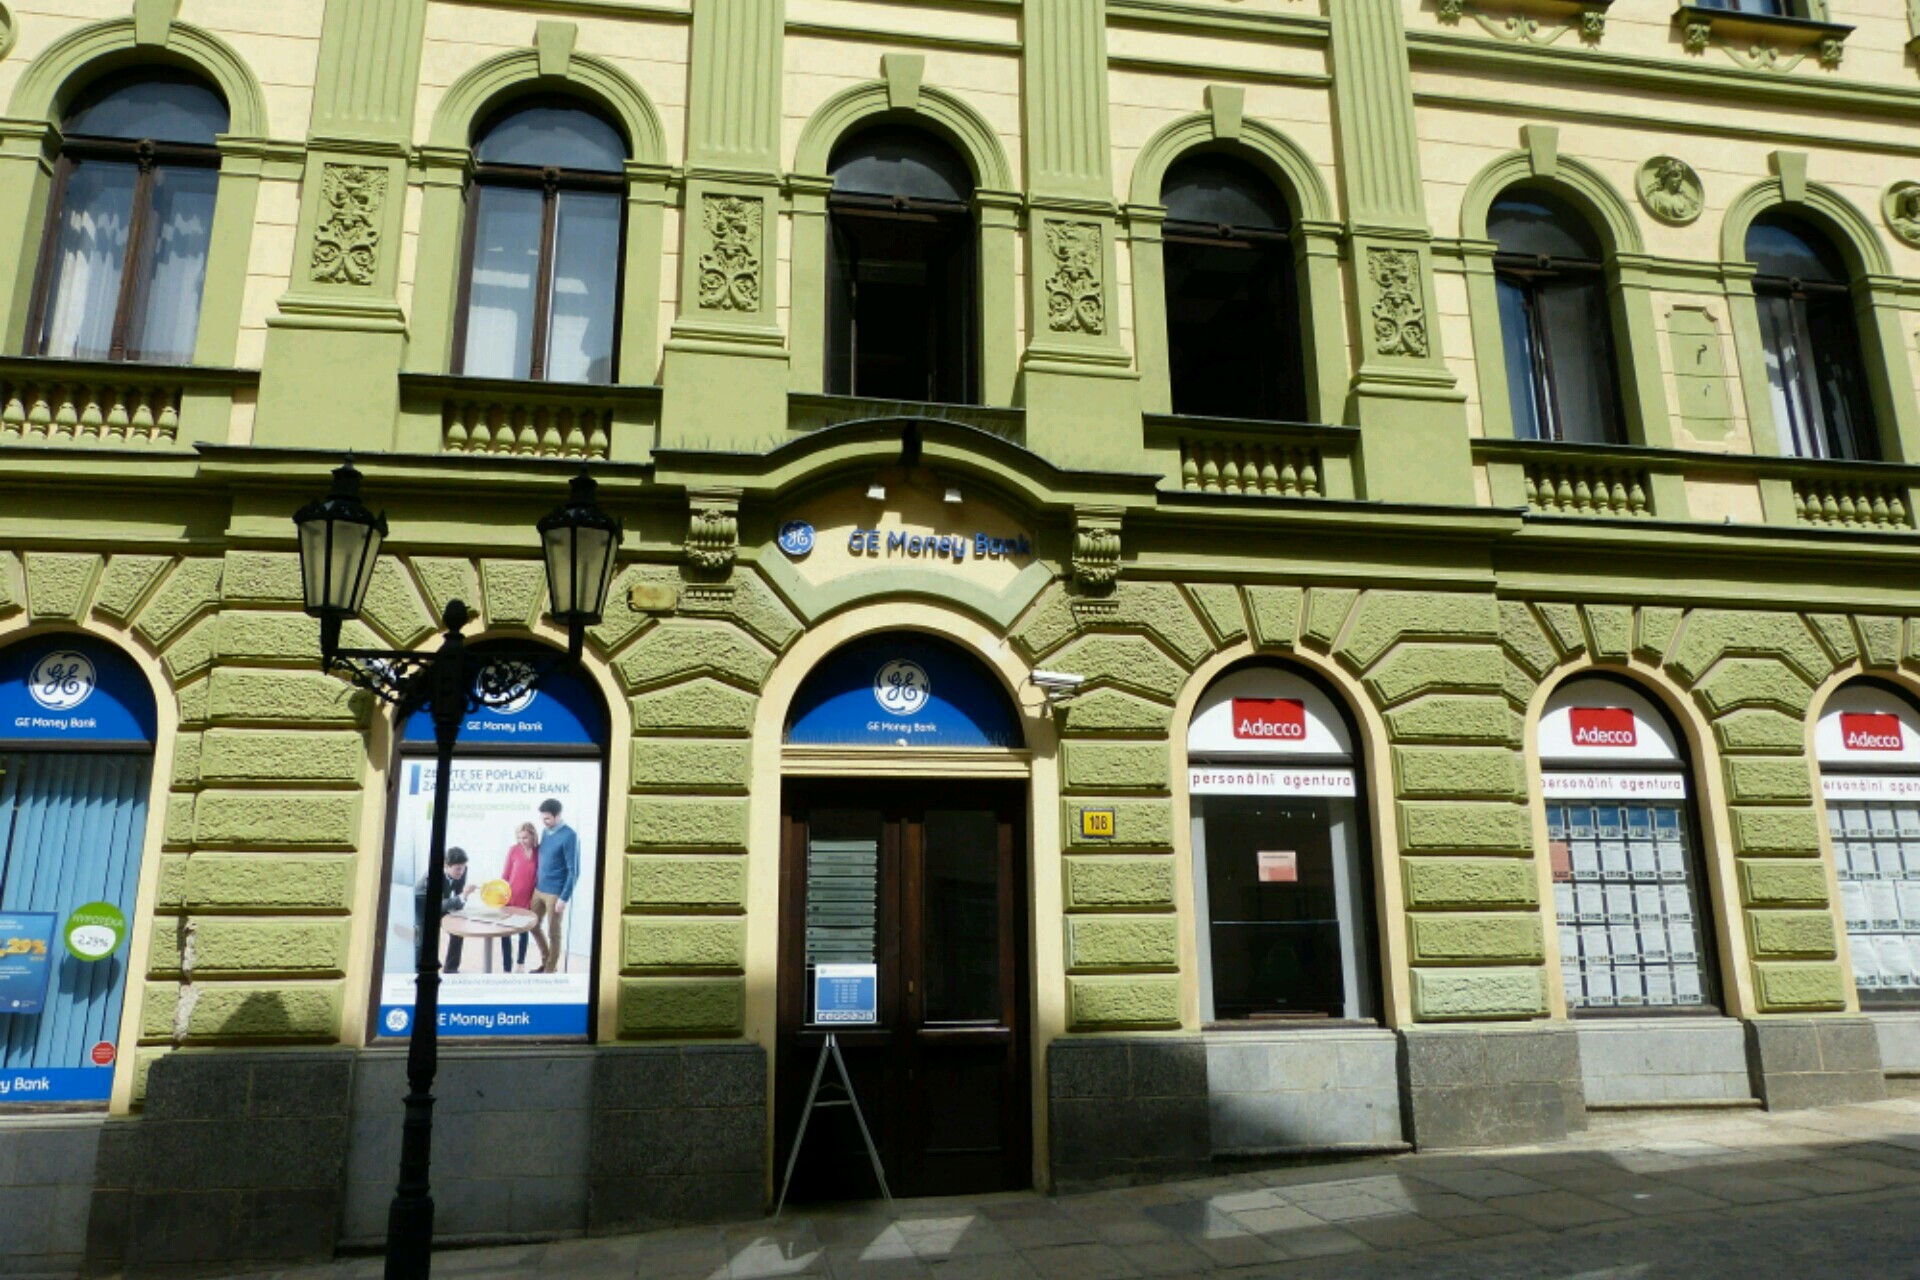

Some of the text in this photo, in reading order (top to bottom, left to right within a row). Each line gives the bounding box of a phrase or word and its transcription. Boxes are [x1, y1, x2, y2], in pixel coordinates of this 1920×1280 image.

[849, 529, 1032, 557] GE Money Bank
[15, 717, 97, 730] GE Money Bank
[466, 721, 543, 733] GE Money Bank
[866, 721, 937, 734] GE Money Bank
[1238, 717, 1302, 736] Adecco
[1576, 726, 1633, 743] Adecco
[1847, 730, 1900, 747] Adecco
[470, 769, 483, 780] SE
[1193, 772, 1352, 789] personální agentura
[486, 782, 493, 792] Z
[539, 783, 570, 794] BANK
[1620, 777, 1681, 791] agentura
[449, 1012, 494, 1028] Money
[497, 1012, 530, 1025] Bank
[14, 1076, 50, 1091] Bank
